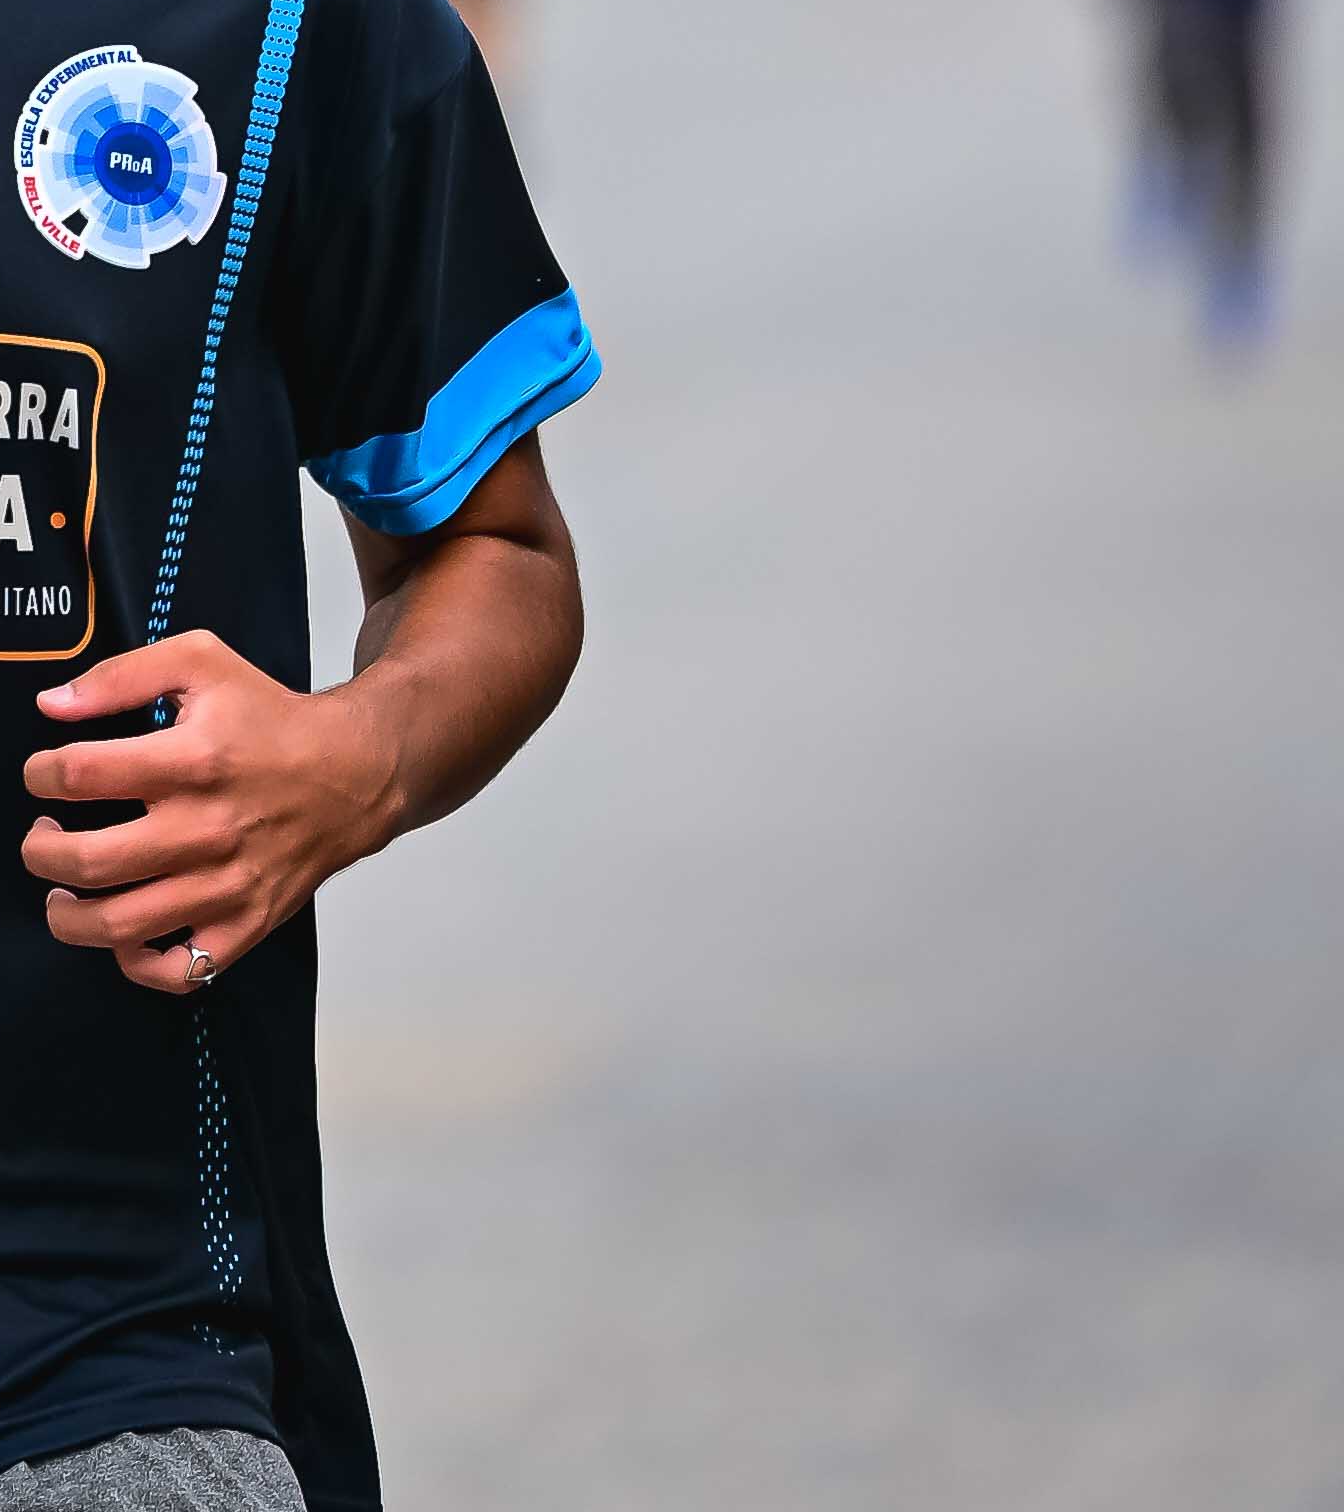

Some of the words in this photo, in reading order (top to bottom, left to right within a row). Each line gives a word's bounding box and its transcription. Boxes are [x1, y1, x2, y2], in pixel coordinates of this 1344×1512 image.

[21, 106, 43, 168] ESCUELA
[37, 50, 137, 105] EXPERIMENTAL
[23, 176, 43, 217] BELL
[41, 216, 81, 254] VILLE
